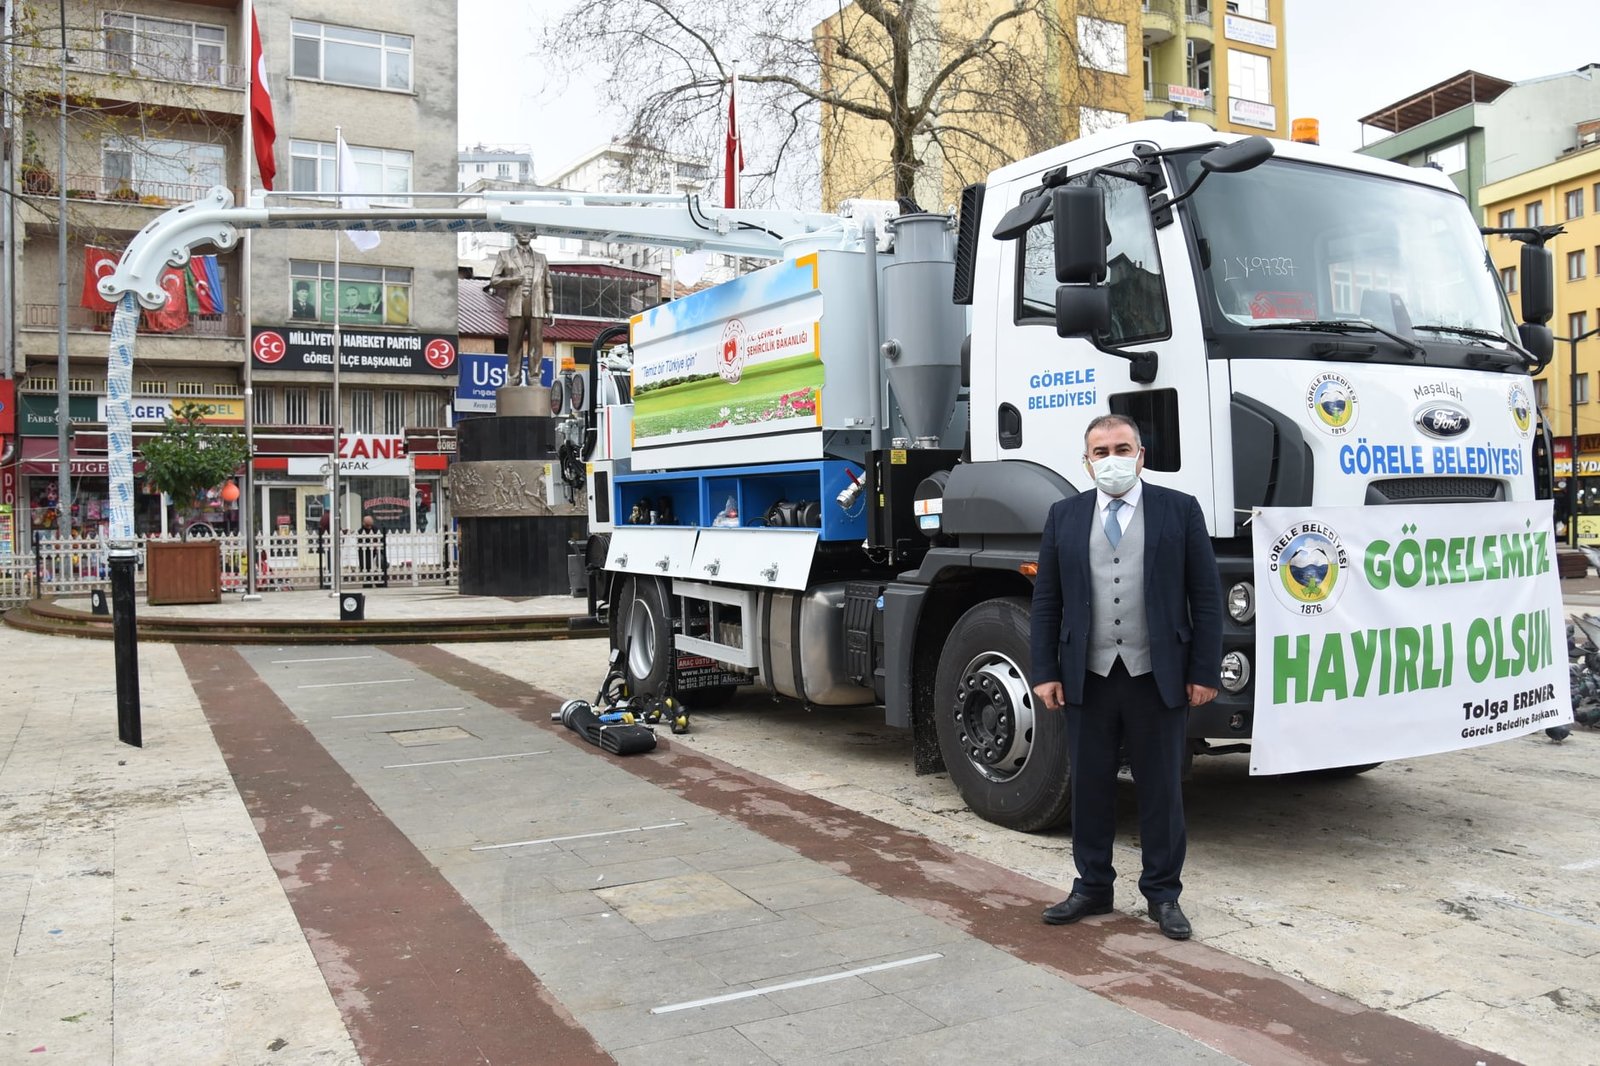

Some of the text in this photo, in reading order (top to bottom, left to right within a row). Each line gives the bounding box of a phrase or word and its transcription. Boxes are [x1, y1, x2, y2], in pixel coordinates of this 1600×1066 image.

[289, 330, 421, 350] MİLLİYETİ HAREKET PARTİSİ
[303, 352, 412, 368] GÖREL İLÇE BAŞKANLIĞI
[1030, 368, 1095, 389] GÖRELE
[1028, 386, 1096, 410] BELEDİYESİ
[1413, 381, 1463, 401] Maşallah
[1433, 410, 1462, 430] Ford
[1331, 427, 1347, 435] 1876
[340, 461, 369, 470] AFAK
[1339, 438, 1523, 476] GÖRELE BELEDİYESİ
[1364, 518, 1550, 590] GÖRELEMİZ
[1301, 603, 1323, 614] 1876
[1273, 608, 1552, 705] HAYIRLI OLSUN
[1463, 683, 1555, 720] Tolga ERENER
[1461, 708, 1559, 738] Görele Belediye Başkanı
